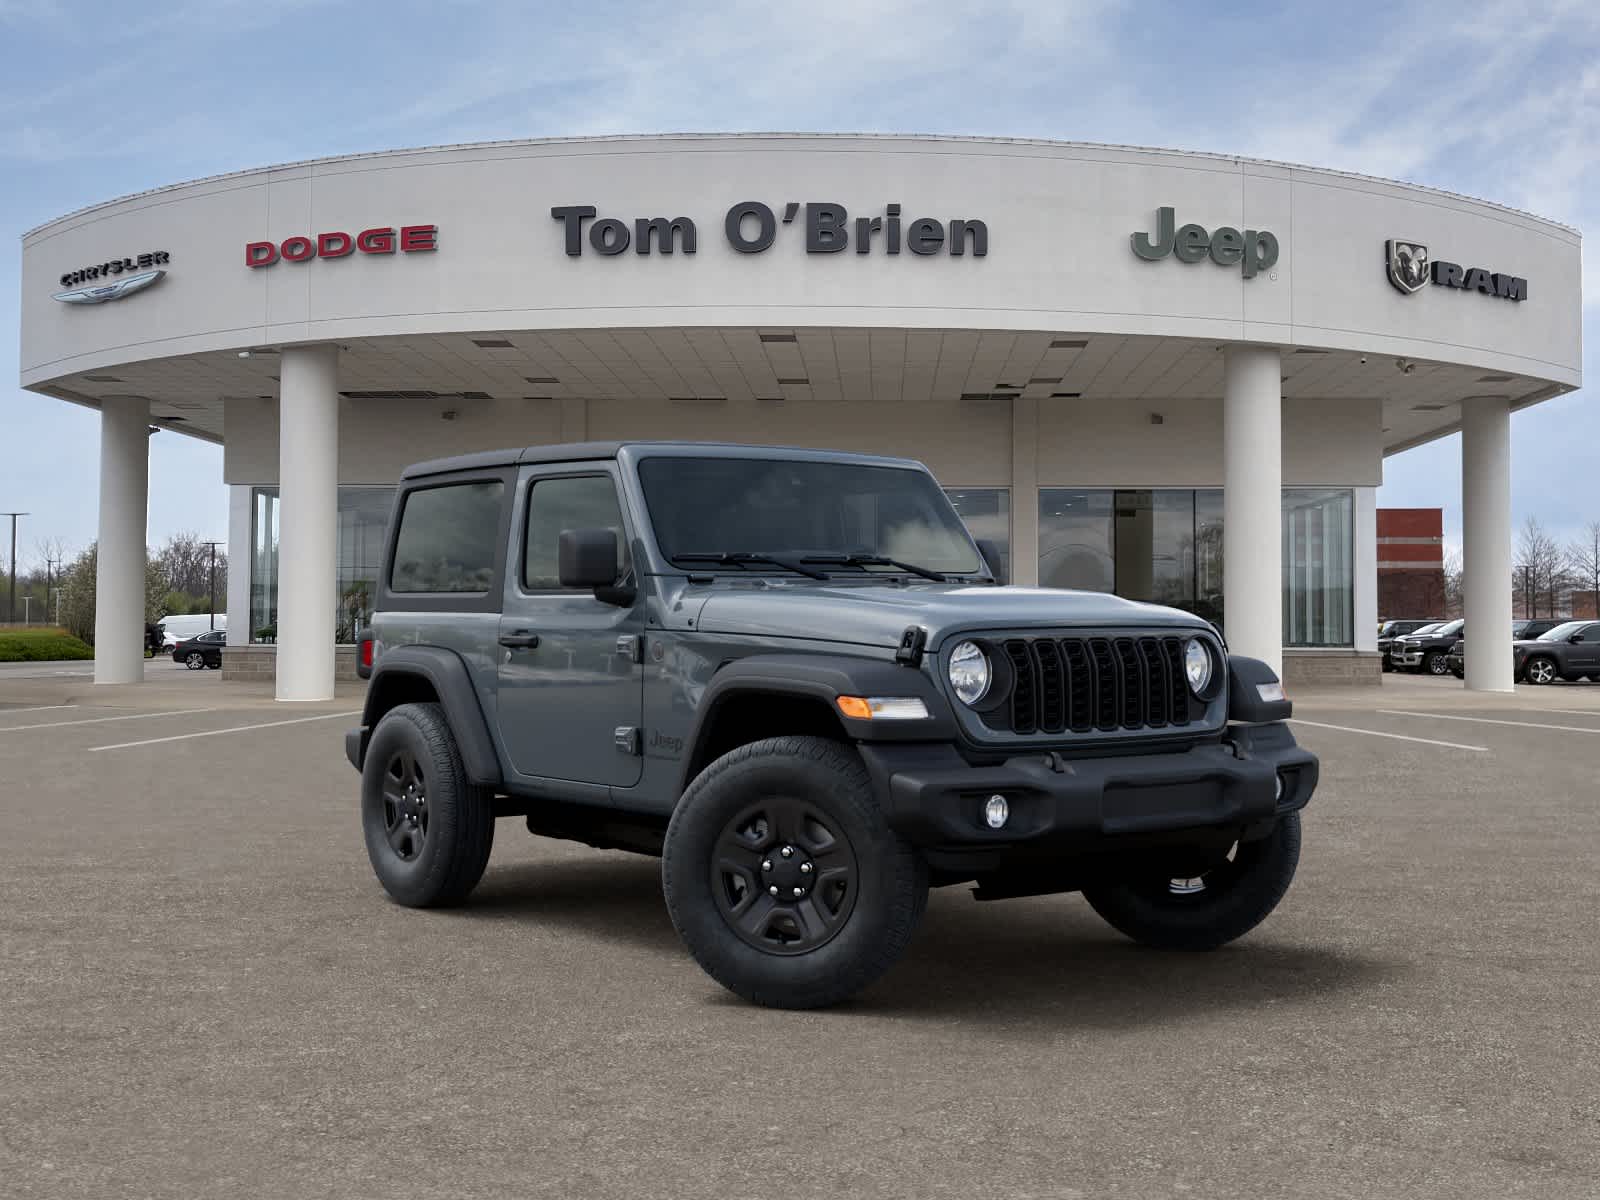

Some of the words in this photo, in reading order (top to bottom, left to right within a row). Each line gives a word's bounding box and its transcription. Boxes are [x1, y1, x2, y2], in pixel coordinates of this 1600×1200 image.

[245, 224, 439, 270] DODGE
[550, 205, 697, 257] Tom
[724, 200, 989, 257] O'Brien
[1130, 206, 1280, 279] Jeep
[59, 249, 170, 288] CHRYSLER
[1430, 260, 1528, 302] RAM
